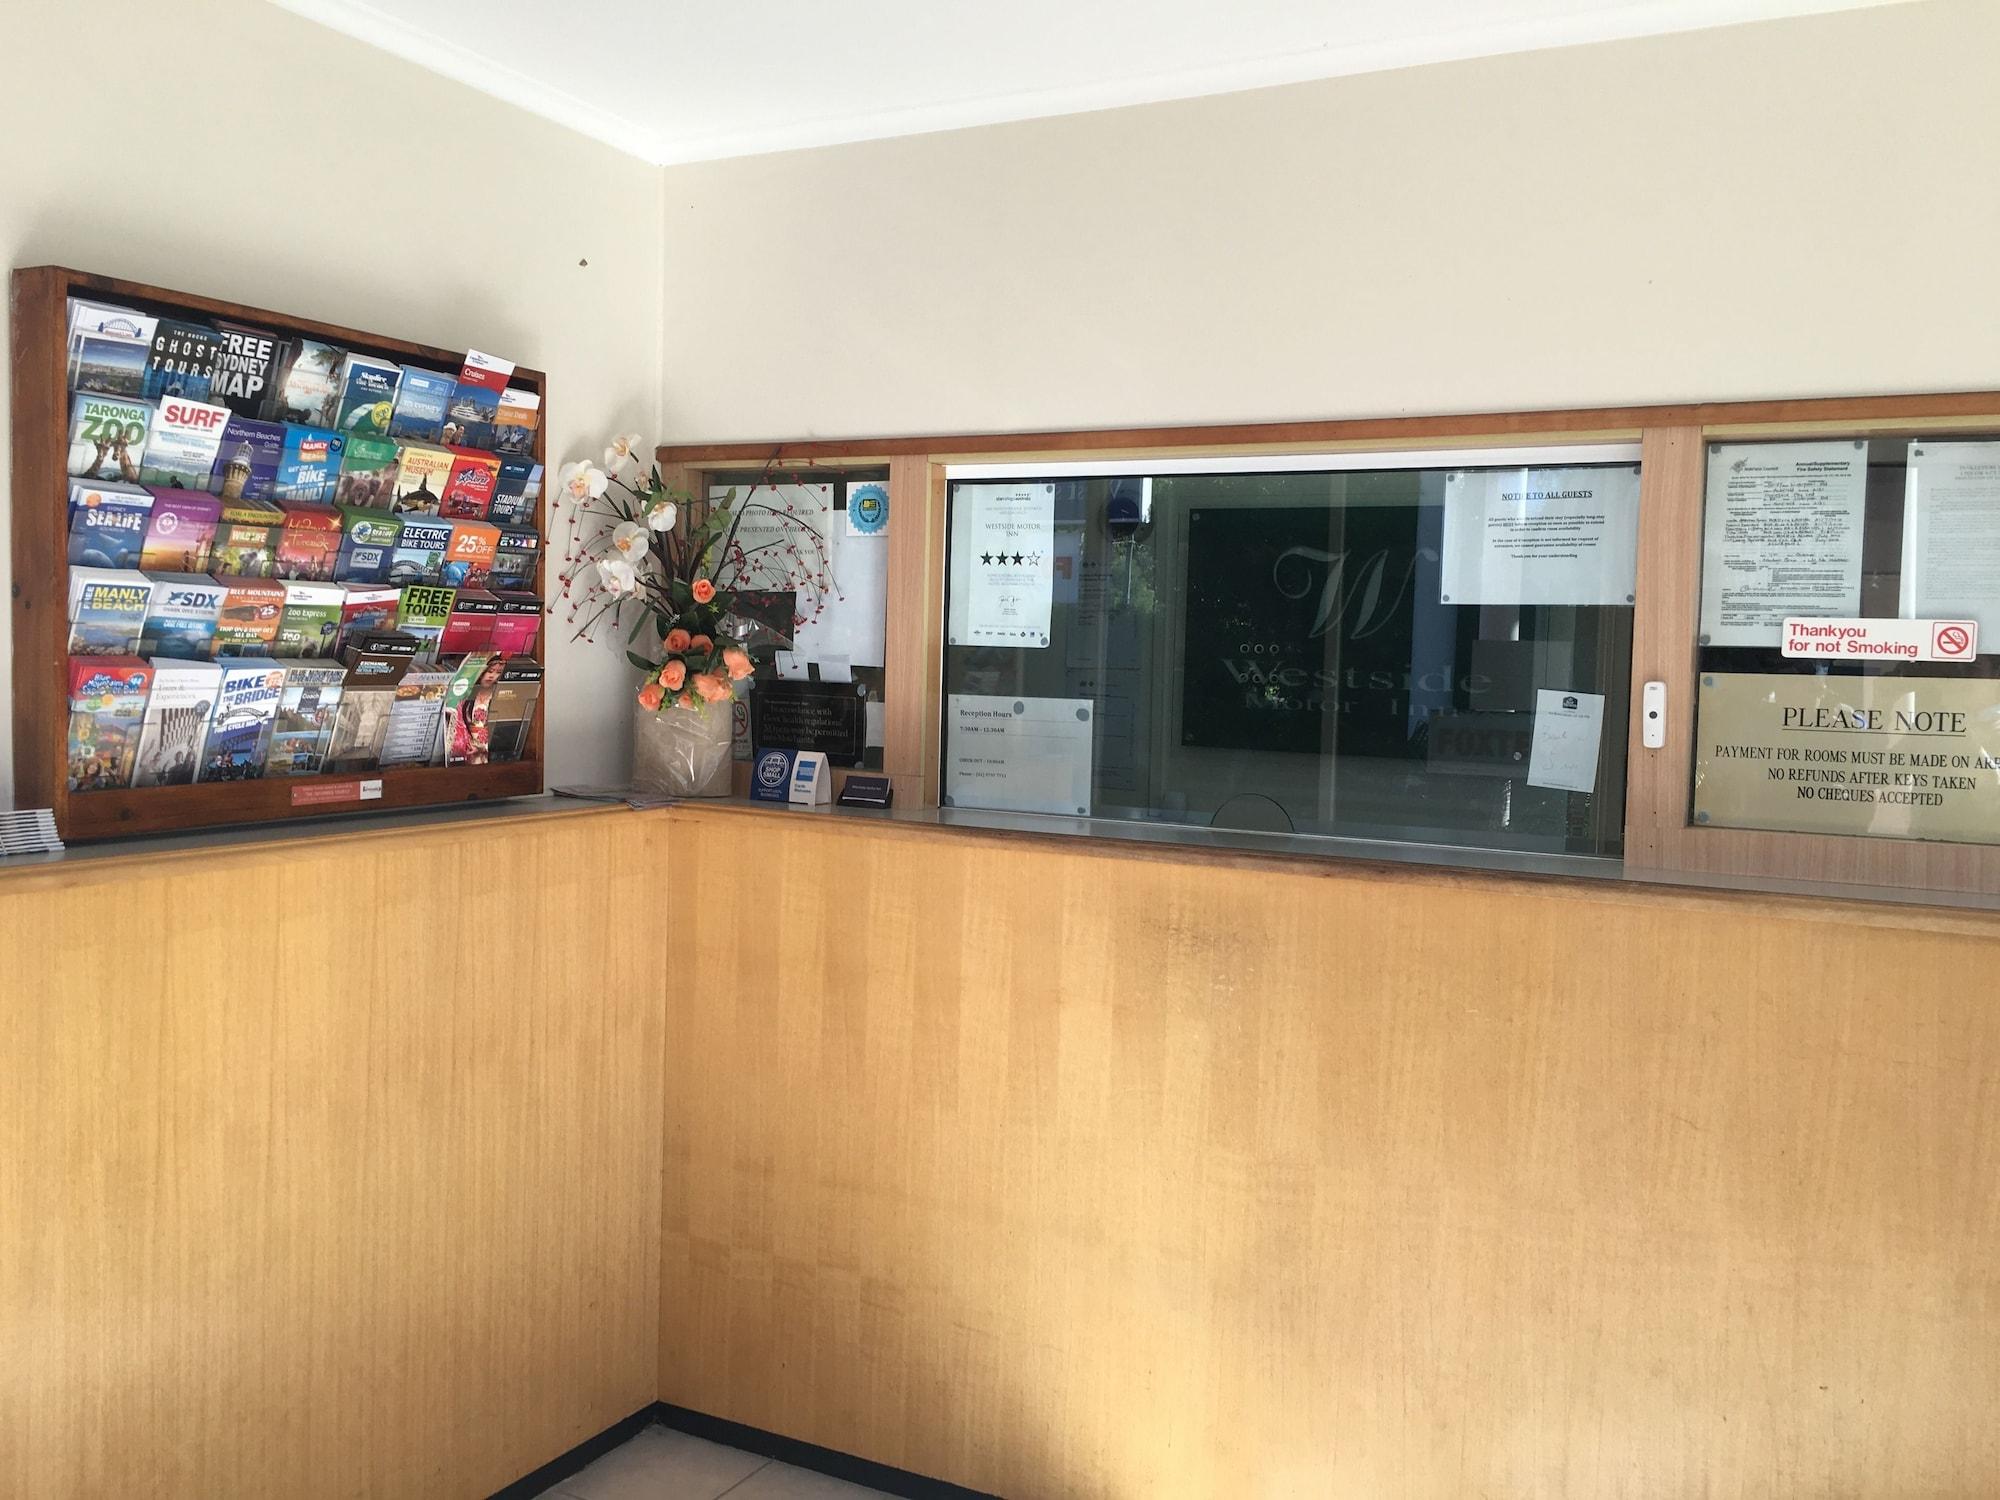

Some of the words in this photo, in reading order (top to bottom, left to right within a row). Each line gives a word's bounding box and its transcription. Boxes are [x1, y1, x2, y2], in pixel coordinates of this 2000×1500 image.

[156, 337, 217, 360] GHOST
[220, 332, 273, 360] FREE
[152, 356, 214, 379] TOURS
[216, 354, 269, 377] SYDNEY
[211, 369, 265, 399] MAP
[85, 402, 146, 423] TARONGA
[164, 405, 225, 429] SURF
[81, 414, 145, 446] ZOO
[227, 427, 256, 438] Northern
[256, 430, 281, 442] Beaches
[303, 441, 328, 451] MANLY
[404, 466, 435, 477] MUSEUM
[406, 457, 450, 471] AUSTRALIAN
[297, 470, 326, 485] BIKE
[495, 494, 525, 506] STADIUM
[1533, 492, 1544, 500] TO
[1544, 491, 1561, 500] ALL
[1562, 490, 1593, 499] GUESTS
[492, 504, 514, 514] TOURS
[86, 508, 115, 527] SEA
[115, 512, 143, 531] LIFE
[985, 523, 1015, 531] WESTSIDE
[1016, 523, 1041, 531] MOTOR
[403, 527, 448, 542] ELECTRIC
[401, 539, 419, 549] BIKE
[420, 540, 445, 551] TOURS
[455, 534, 478, 554] 25
[476, 545, 494, 555] OFF
[361, 552, 380, 562] SDX
[94, 587, 148, 599] MANLY
[181, 592, 220, 610] SDX
[247, 589, 285, 597] MOUNTAINS
[407, 588, 454, 606] FREE
[91, 598, 145, 611] BEACH
[405, 604, 448, 618] TOURS
[287, 609, 301, 618] Zoo
[302, 609, 327, 620] Express
[1789, 624, 1866, 640] Thankyou
[1789, 639, 1810, 651] for
[1815, 641, 1840, 653] not
[1847, 640, 1918, 657] Smoking
[224, 675, 267, 694] BIKE
[1221, 657, 1495, 695] Westside
[223, 694, 235, 703] THE
[234, 687, 281, 706] BRIDGE
[960, 709, 992, 719] Reception
[992, 710, 1013, 718] Hours
[1783, 706, 1885, 730] PLEASE
[1895, 710, 1967, 734] NOTE
[1714, 745, 1773, 760] PAYMENT
[1776, 748, 1800, 761] FOR
[1804, 749, 1847, 763] ROOMS
[1850, 751, 1886, 765] MUST
[1889, 753, 1906, 766] BE
[1909, 754, 1948, 768] MADE
[1951, 755, 1970, 768] ON
[1767, 768, 1785, 781] NO
[1788, 768, 1846, 784] REFUNDS
[1849, 771, 1890, 786] AFTER
[1894, 773, 1929, 788] KEYS
[1932, 775, 1977, 790] TAKEN
[1796, 786, 1815, 800] NO
[1818, 787, 1875, 803] CHEQUES
[1878, 789, 1944, 807] ACCEPTED
